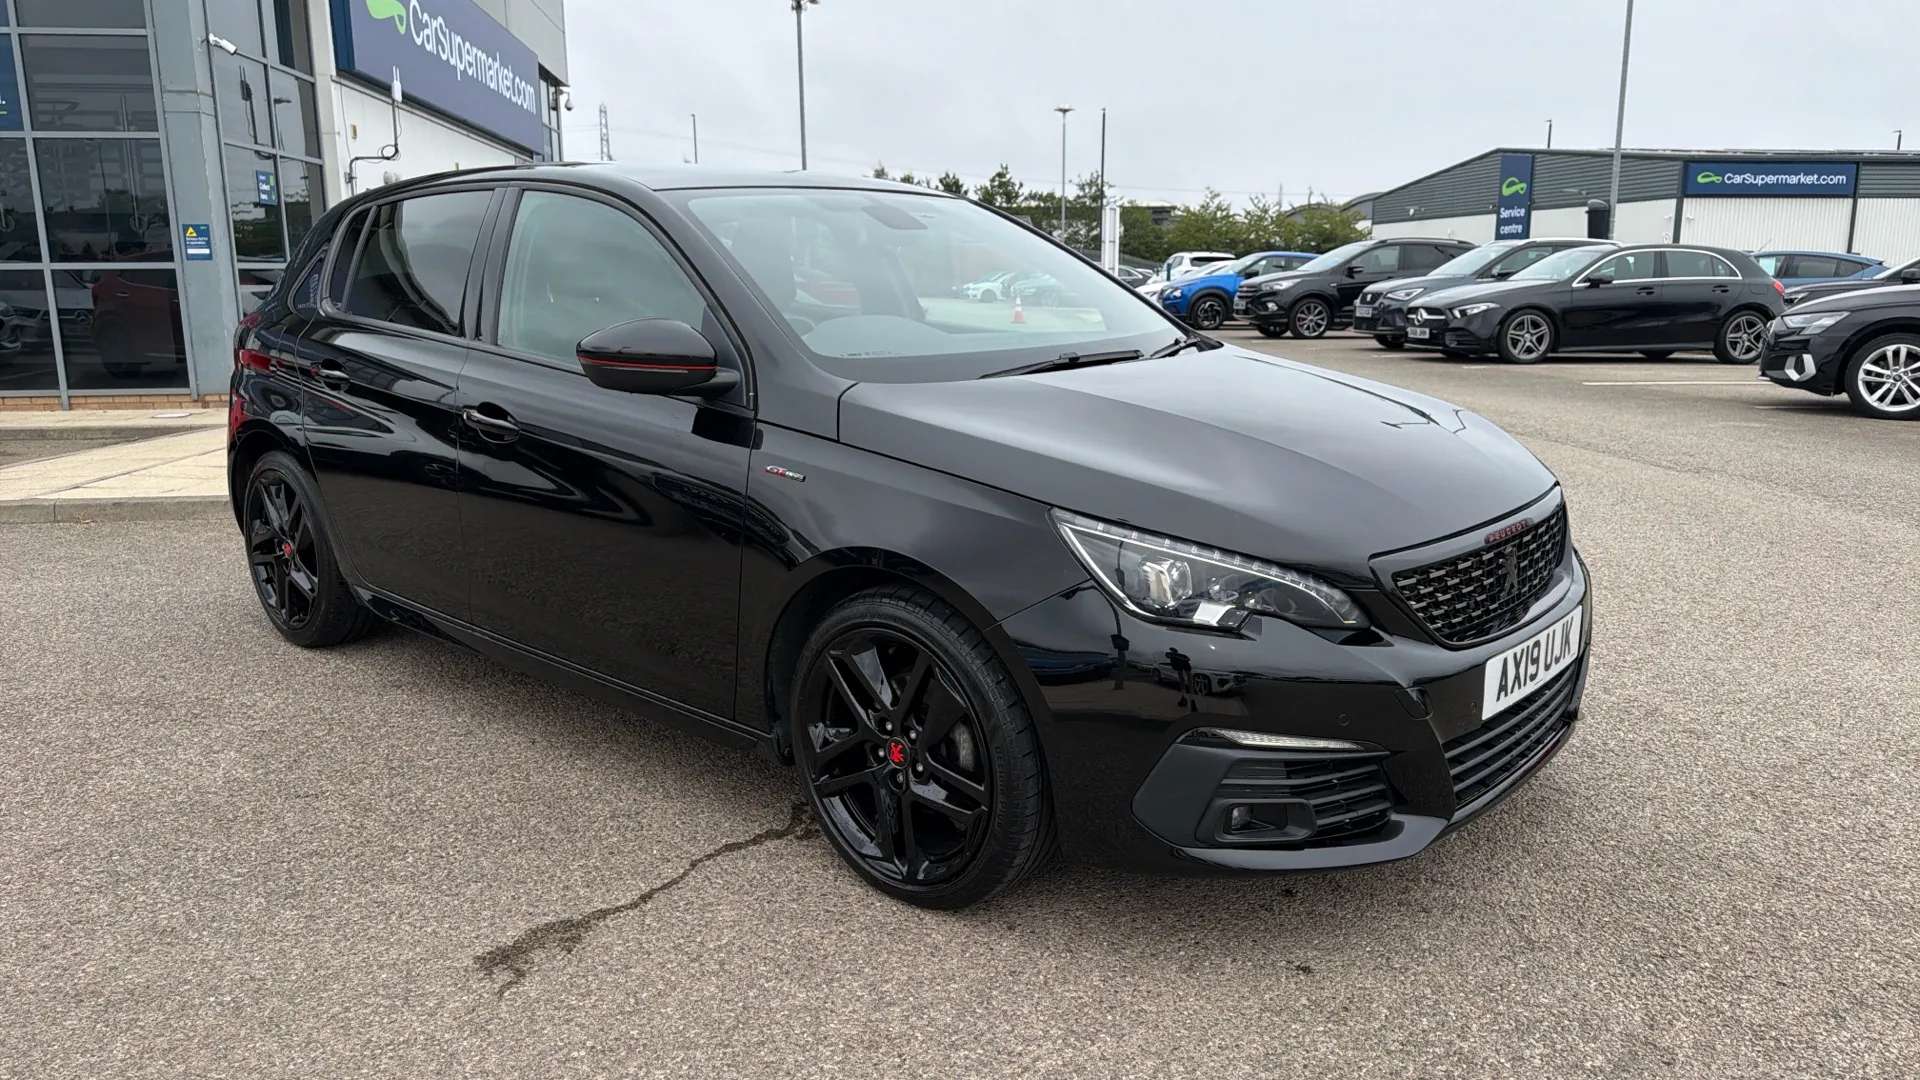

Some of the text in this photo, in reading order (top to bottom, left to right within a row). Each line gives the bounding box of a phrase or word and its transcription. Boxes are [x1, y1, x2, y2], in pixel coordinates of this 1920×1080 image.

[409, 0, 536, 114] CarSupermarket.com
[1724, 172, 1847, 187] CarSupermarket.com
[1500, 206, 1525, 218] Service
[1500, 224, 1523, 234] centre
[1487, 519, 1528, 542] PEUGEOT
[1496, 616, 1574, 702] AX19 UJK
